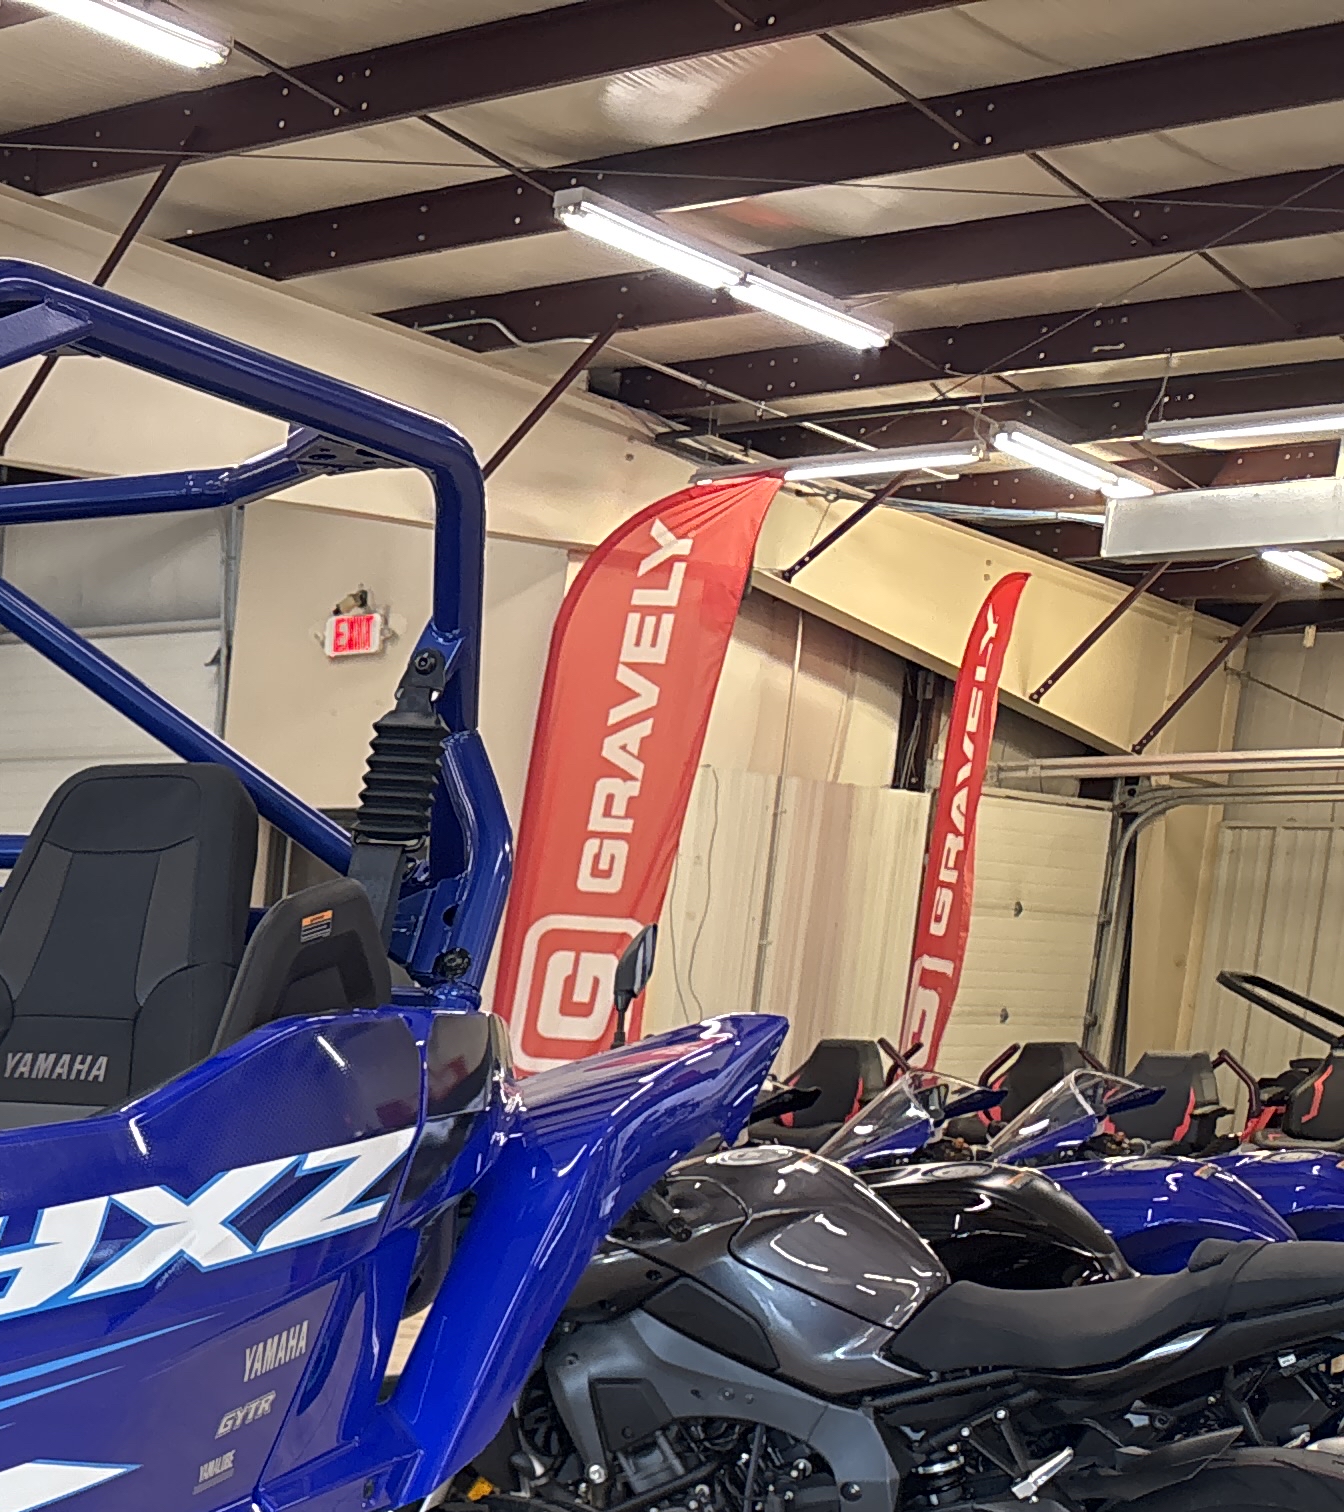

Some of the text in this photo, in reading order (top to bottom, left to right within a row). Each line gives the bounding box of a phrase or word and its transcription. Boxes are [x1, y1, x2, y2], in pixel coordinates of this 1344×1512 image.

[333, 614, 374, 653] EXIT
[576, 518, 694, 893] GRAVELY
[3, 1050, 109, 1084] YAMAHA
[243, 1319, 310, 1383] YAMAHA
[214, 1389, 278, 1441] GYTR
